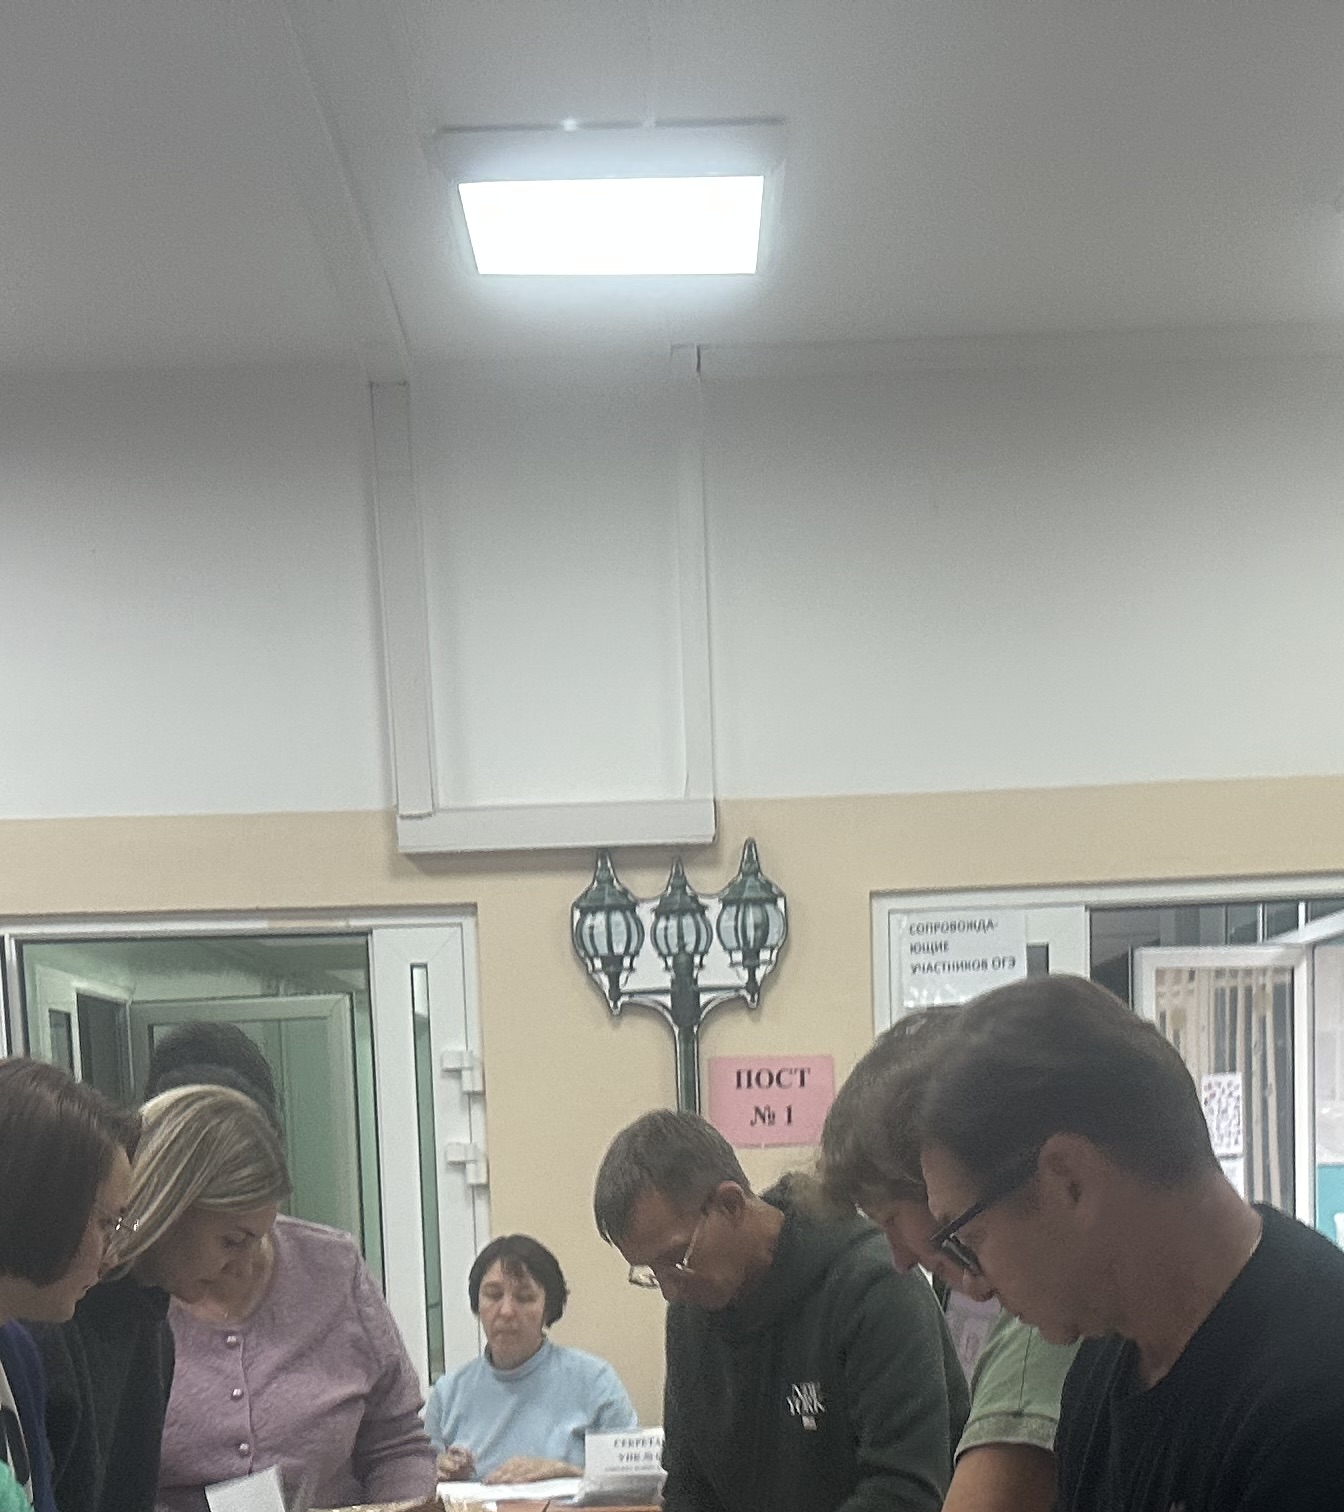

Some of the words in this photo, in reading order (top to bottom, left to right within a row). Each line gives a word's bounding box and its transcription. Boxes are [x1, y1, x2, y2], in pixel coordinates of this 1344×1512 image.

[909, 918, 998, 936] СОПРОВОЖДА-
[909, 940, 949, 955] ЮЩИЕ
[911, 958, 989, 975] УЧАСТНИКОВ
[991, 956, 1016, 971] ОГЭ
[735, 1067, 811, 1090] ПОСТ
[749, 1104, 775, 1127] №
[786, 1104, 793, 1125] 1
[613, 1435, 662, 1448] СЕКРЕТА
